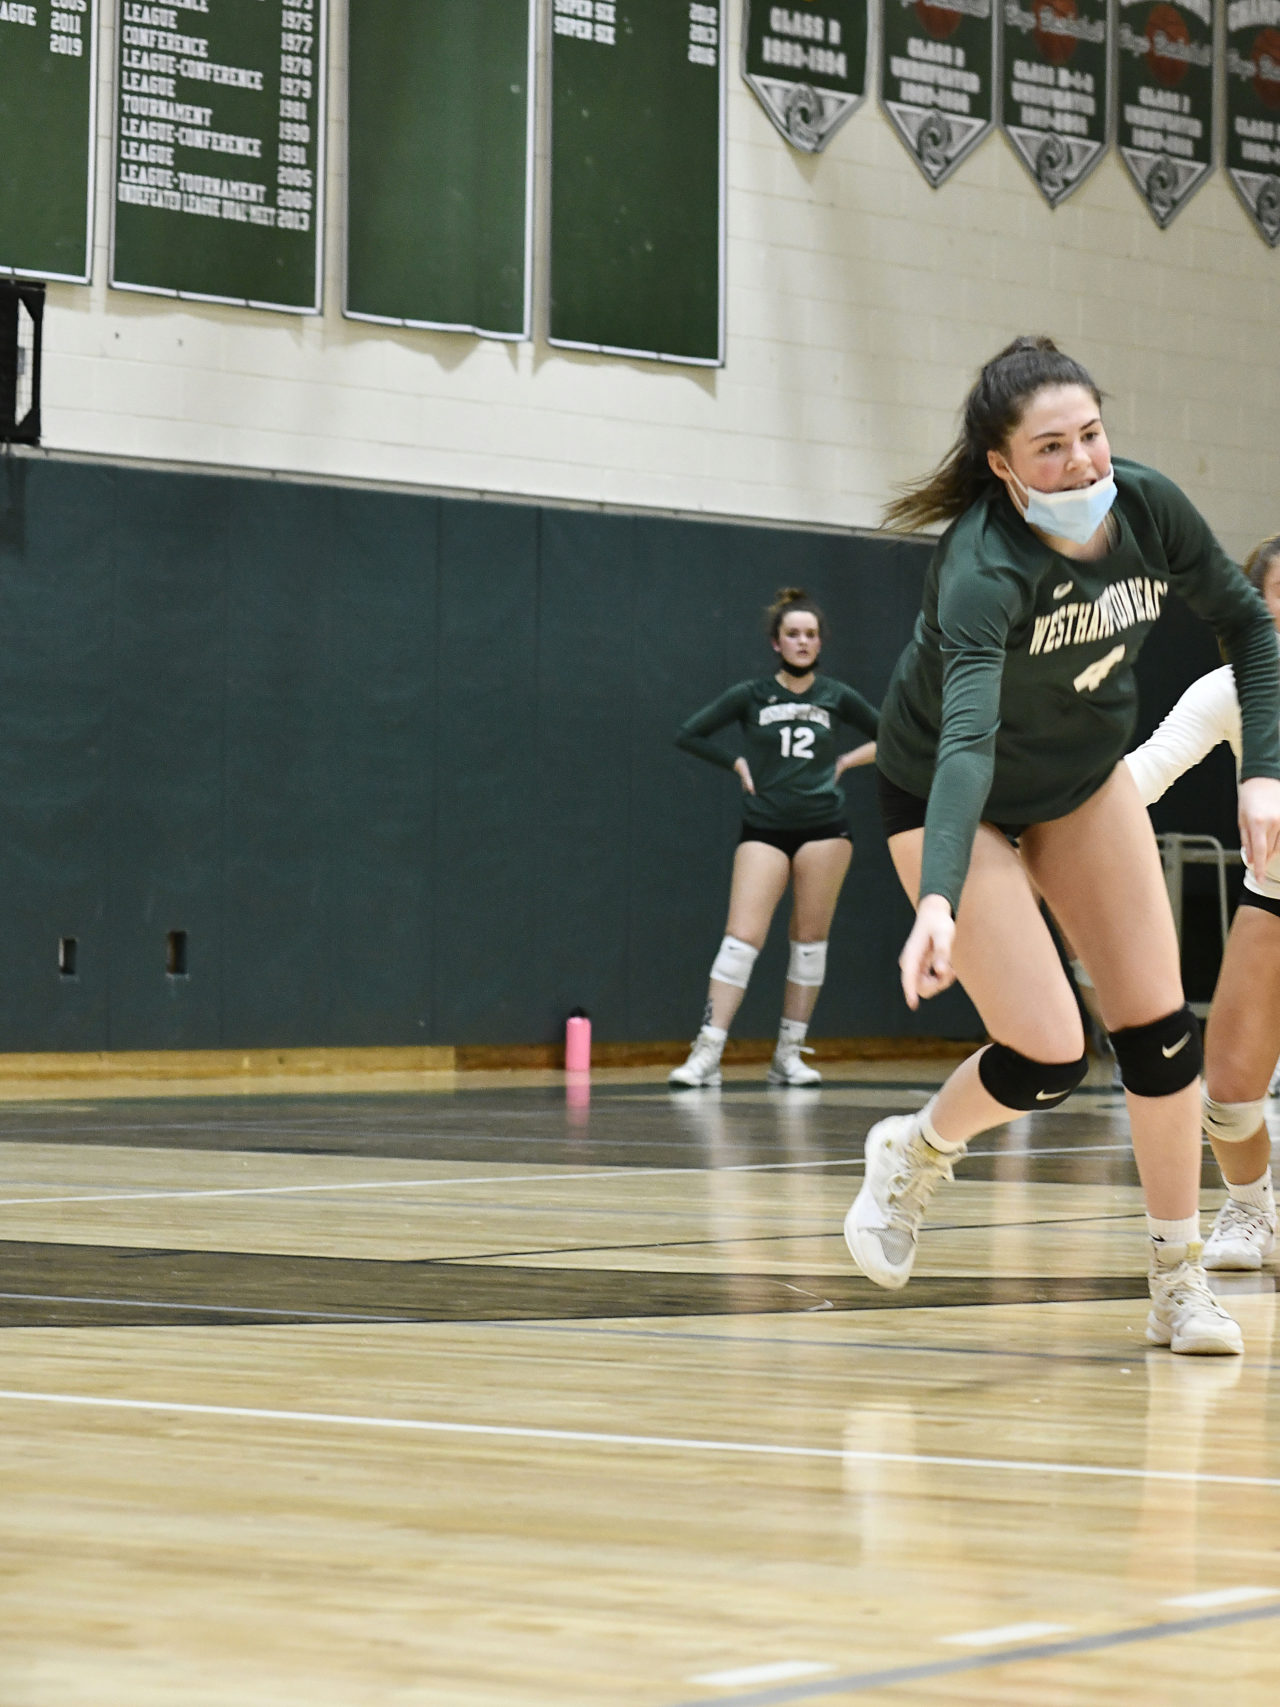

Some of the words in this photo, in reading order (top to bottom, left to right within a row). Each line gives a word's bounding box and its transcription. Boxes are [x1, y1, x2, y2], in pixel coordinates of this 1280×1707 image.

[50, 11, 81, 35] 2011
[124, 2, 178, 30] LEAGUE
[281, 32, 313, 54] 1977
[282, 9, 313, 32] 1975
[770, 6, 824, 41] CLASS
[50, 33, 83, 57] 2019
[122, 24, 209, 58] CONFERENCE
[121, 70, 176, 98] LEAGUE
[122, 47, 264, 91] LEAGUE-CONFERENCE
[121, 94, 213, 128] TOURNAMENT
[120, 139, 175, 167] LEAGUE
[121, 116, 262, 158] LEAGUE-CONFERENCE
[1073, 643, 1126, 692] 4
[779, 726, 815, 759] 12
